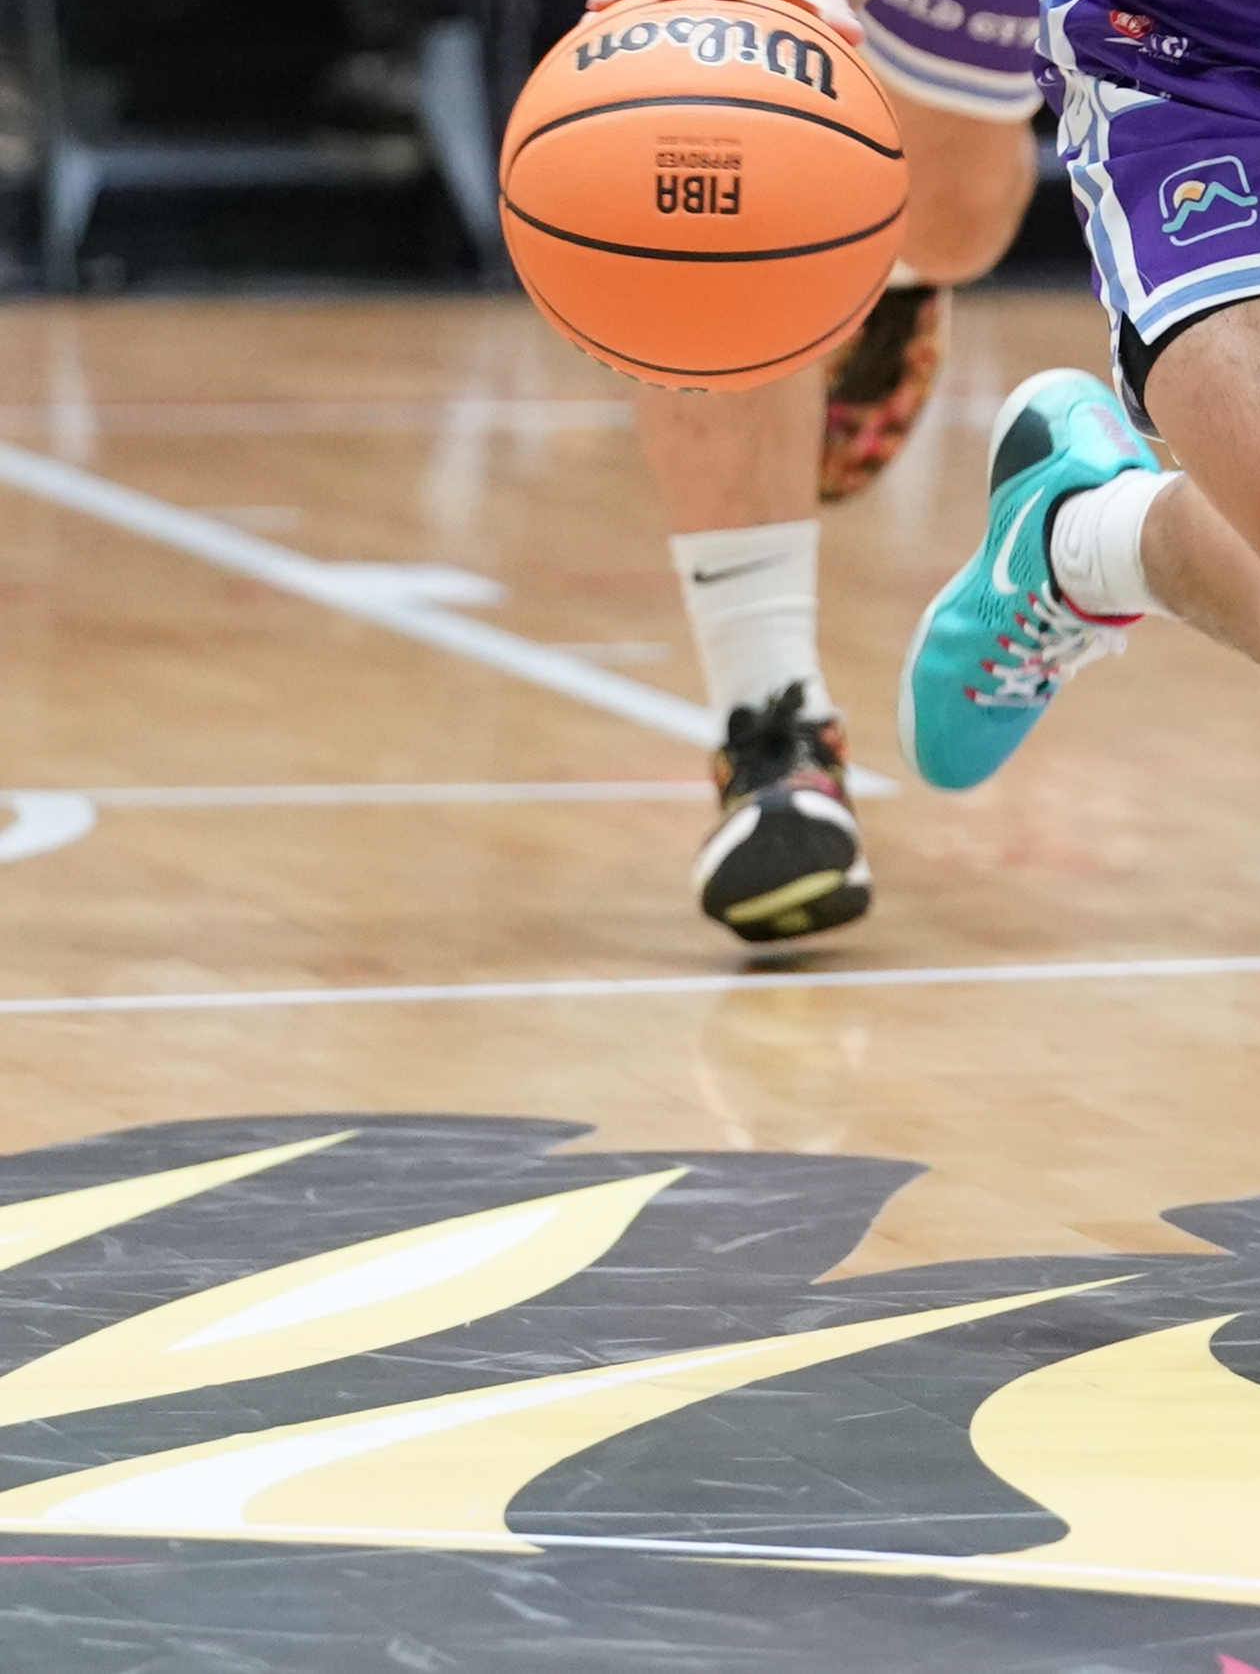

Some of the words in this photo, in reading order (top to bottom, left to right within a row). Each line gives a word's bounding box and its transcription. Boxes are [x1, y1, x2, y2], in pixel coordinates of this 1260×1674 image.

[575, 16, 838, 101] Wilson
[656, 152, 742, 170] APPROVED
[656, 174, 741, 215] FIBA
